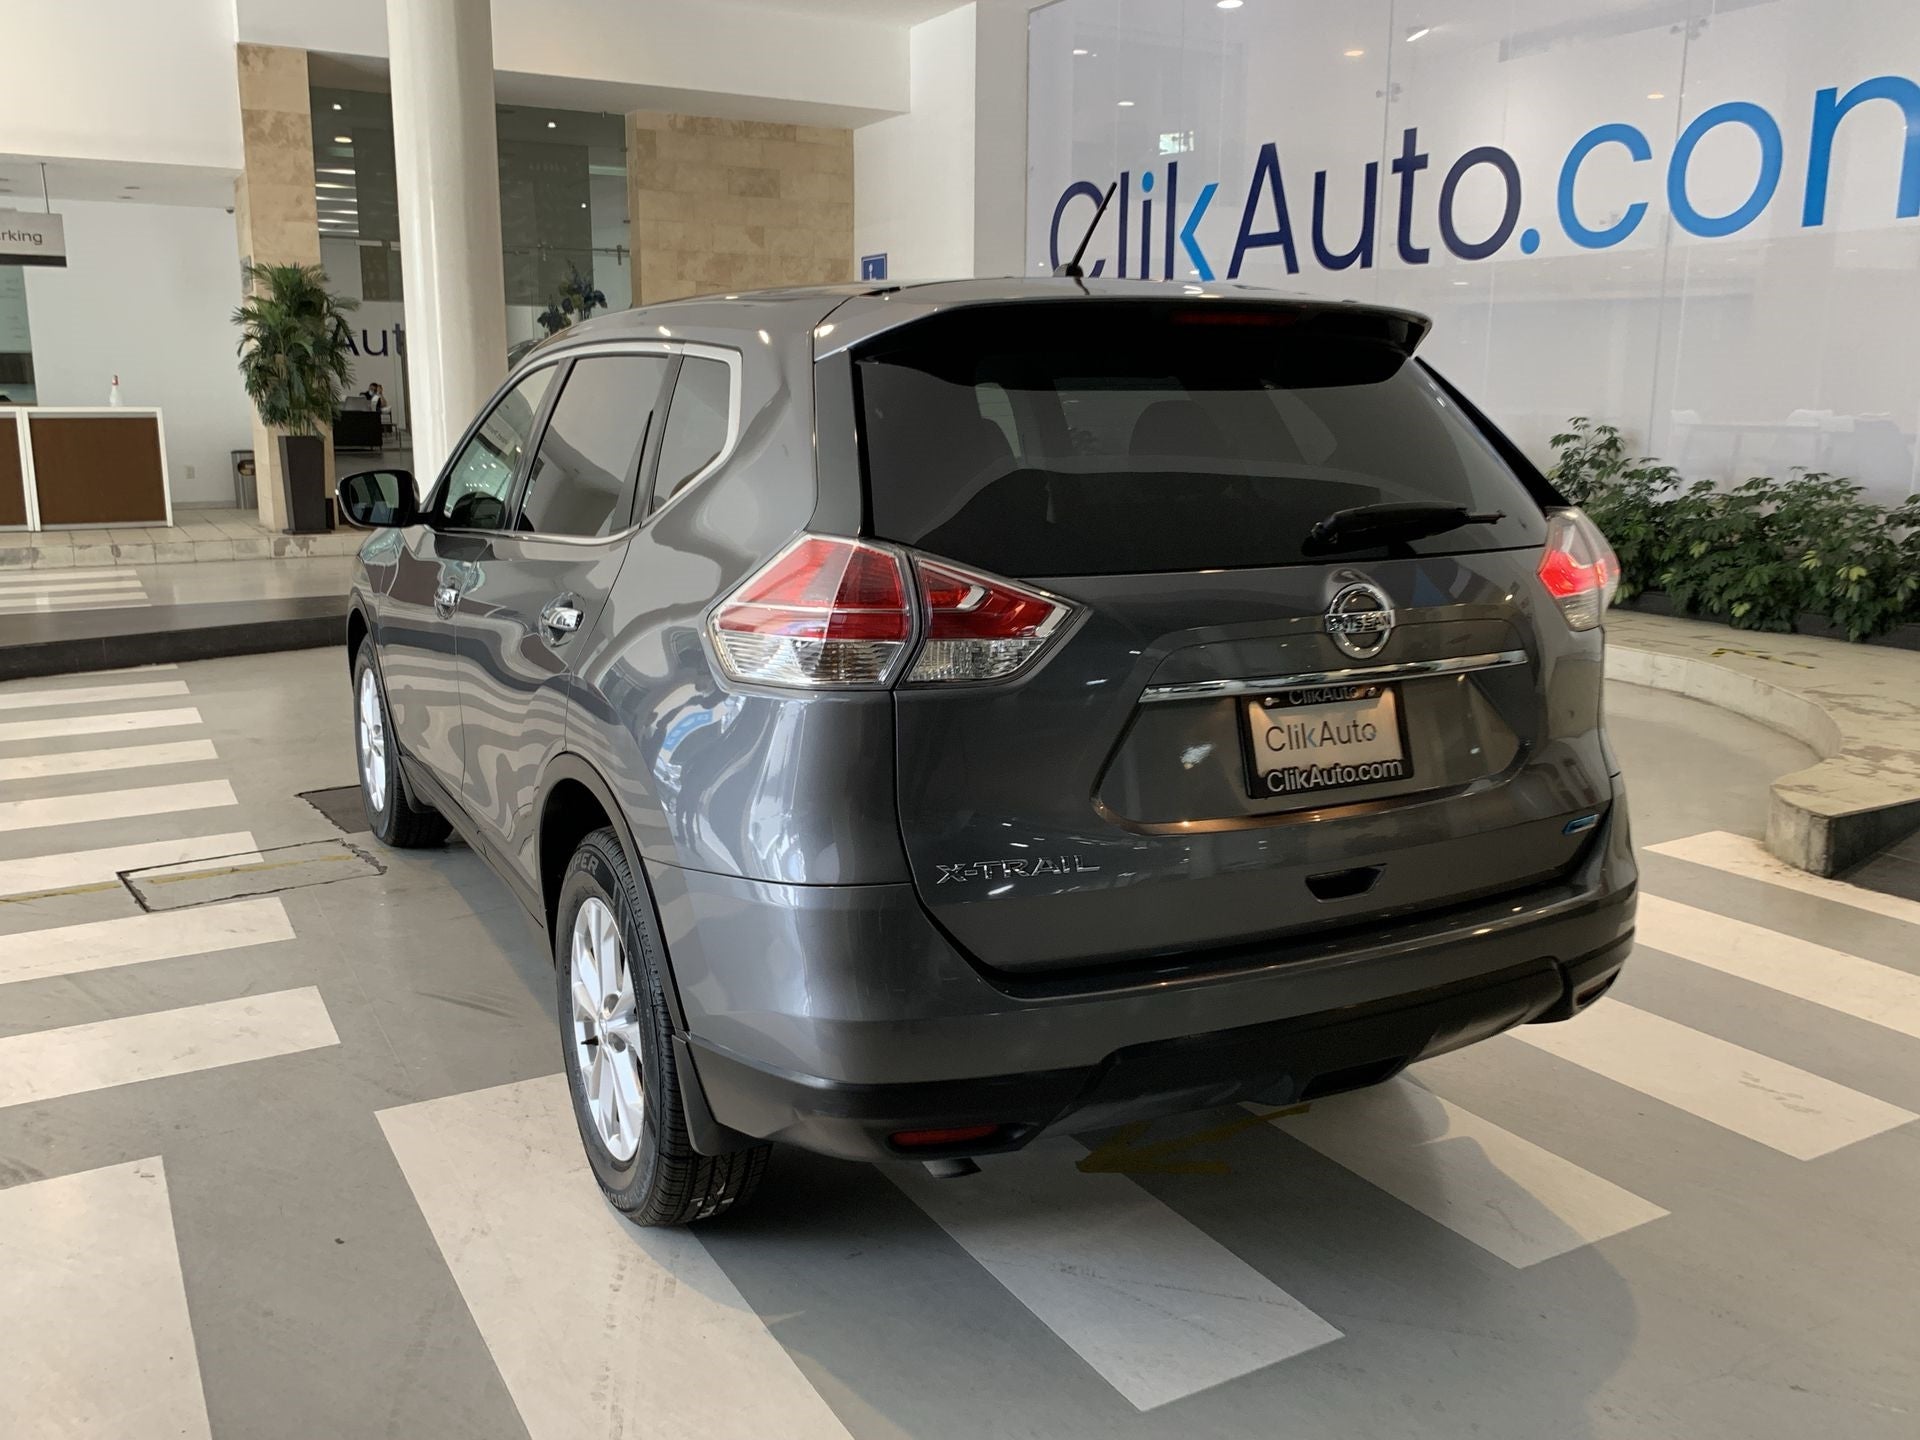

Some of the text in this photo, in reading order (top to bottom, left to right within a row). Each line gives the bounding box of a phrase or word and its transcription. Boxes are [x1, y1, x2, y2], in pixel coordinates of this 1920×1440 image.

[0, 230, 43, 246] rking
[1265, 720, 1377, 752] ClikAuto
[1266, 761, 1403, 792] ClikAuto.com
[935, 854, 1101, 885] X-TRAIL
